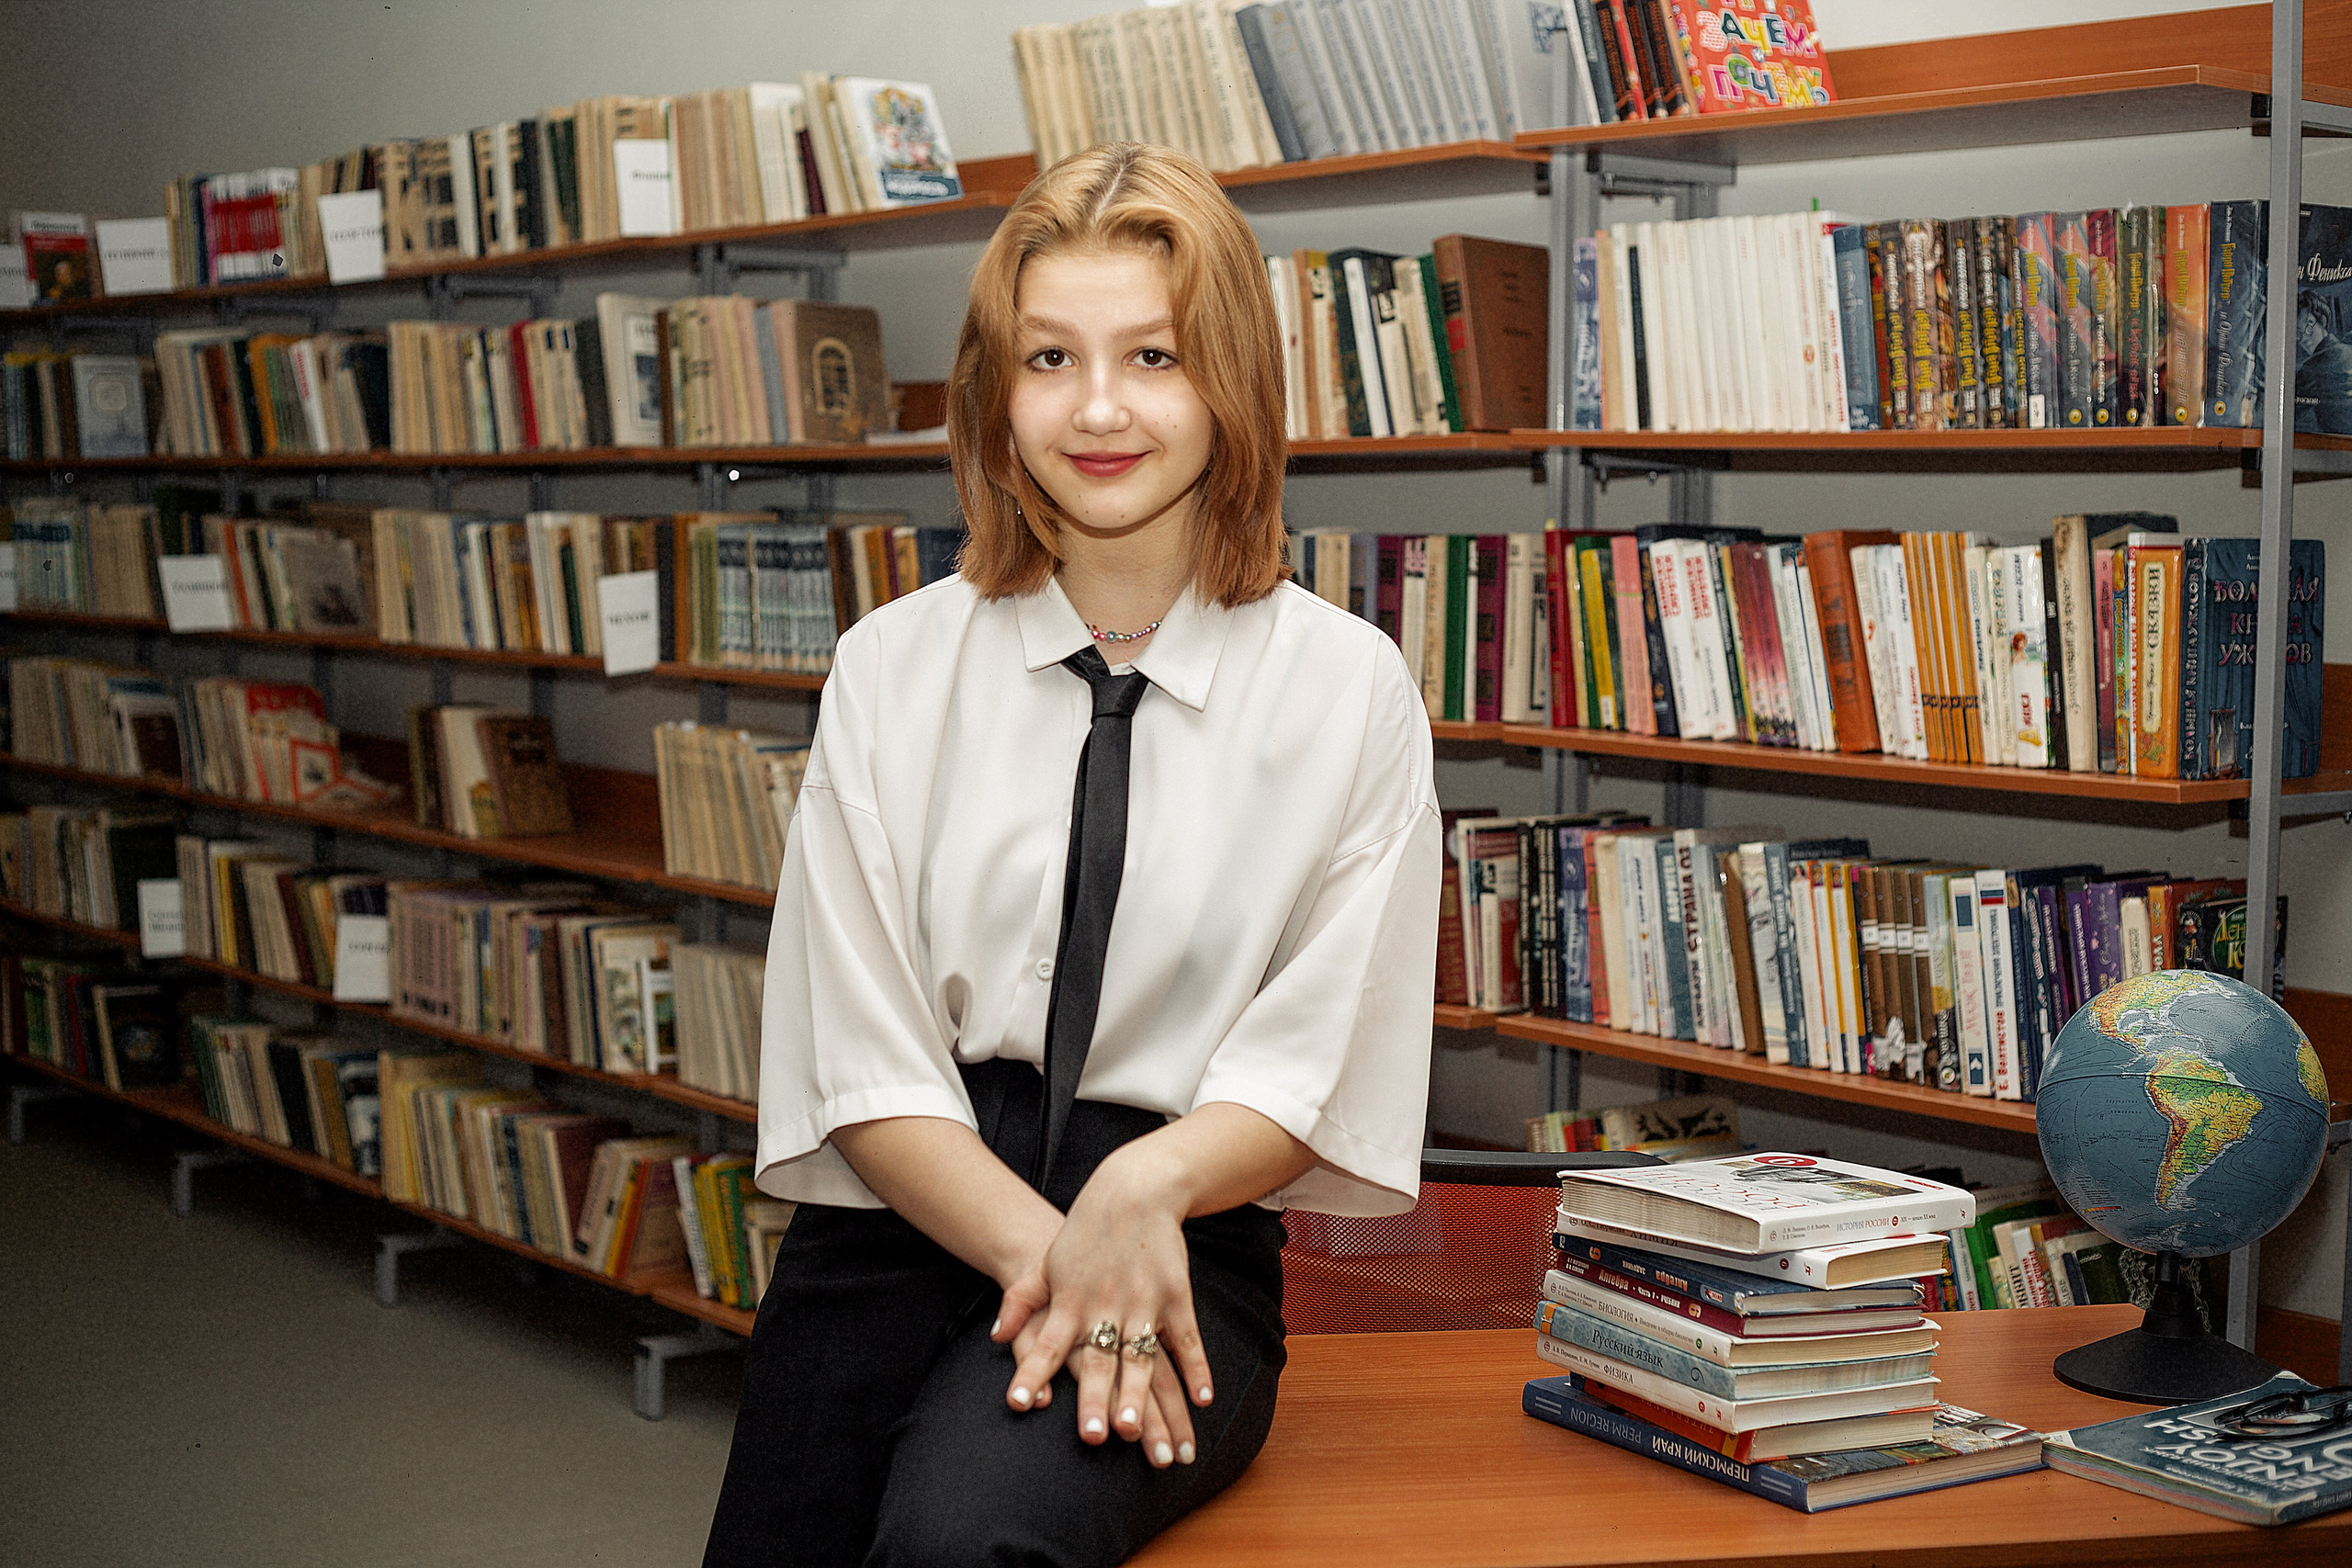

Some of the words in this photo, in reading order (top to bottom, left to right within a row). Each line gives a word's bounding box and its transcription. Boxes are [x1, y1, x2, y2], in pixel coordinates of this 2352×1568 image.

[1696, 8, 1818, 57] ЗАЧЕМ
[2128, 252, 2143, 277] Гарри
[2174, 250, 2191, 275] Гарри
[2220, 243, 2236, 268] Гарри
[2129, 277, 2143, 310] Поттер
[2176, 276, 2190, 307] Поттер
[2221, 268, 2235, 300] Поттер
[2215, 320, 2233, 351] Орден
[2216, 352, 2233, 398] Феникса
[2213, 575, 2321, 604] БОЛАЯ
[2147, 568, 2162, 649] СКАЗКИ
[2230, 613, 2301, 636] КНА
[2218, 640, 2312, 666] УЖОВ
[1681, 875, 1698, 953] СТРАНА
[1995, 1009, 2008, 1077] Велтистов
[1997, 1077, 2009, 1092] Е.
[1837, 1220, 1864, 1233] ИСТОРИЯ
[1864, 1217, 1890, 1229] РОССИИ
[1589, 1246, 1601, 1261] 9
[1598, 1269, 1630, 1291] Алгебра
[1637, 1286, 1652, 1299] Часть
[1660, 1294, 1681, 1309] УЧЕБНИК
[1655, 1269, 1689, 1292] Алгебра
[1598, 1301, 1634, 1323] БИОЛОГИЯ
[1591, 1328, 1634, 1358] Русский
[1634, 1349, 1664, 1370] язык
[1603, 1364, 1634, 1384] ФИЗИКА
[1570, 1407, 1610, 1432] REGION
[1611, 1420, 1642, 1444] PERM
[1651, 1435, 1682, 1459] КРАЙ
[1684, 1449, 1750, 1483] ПЕРМСКИЙ
[2154, 1442, 2328, 1491] ENJOY
